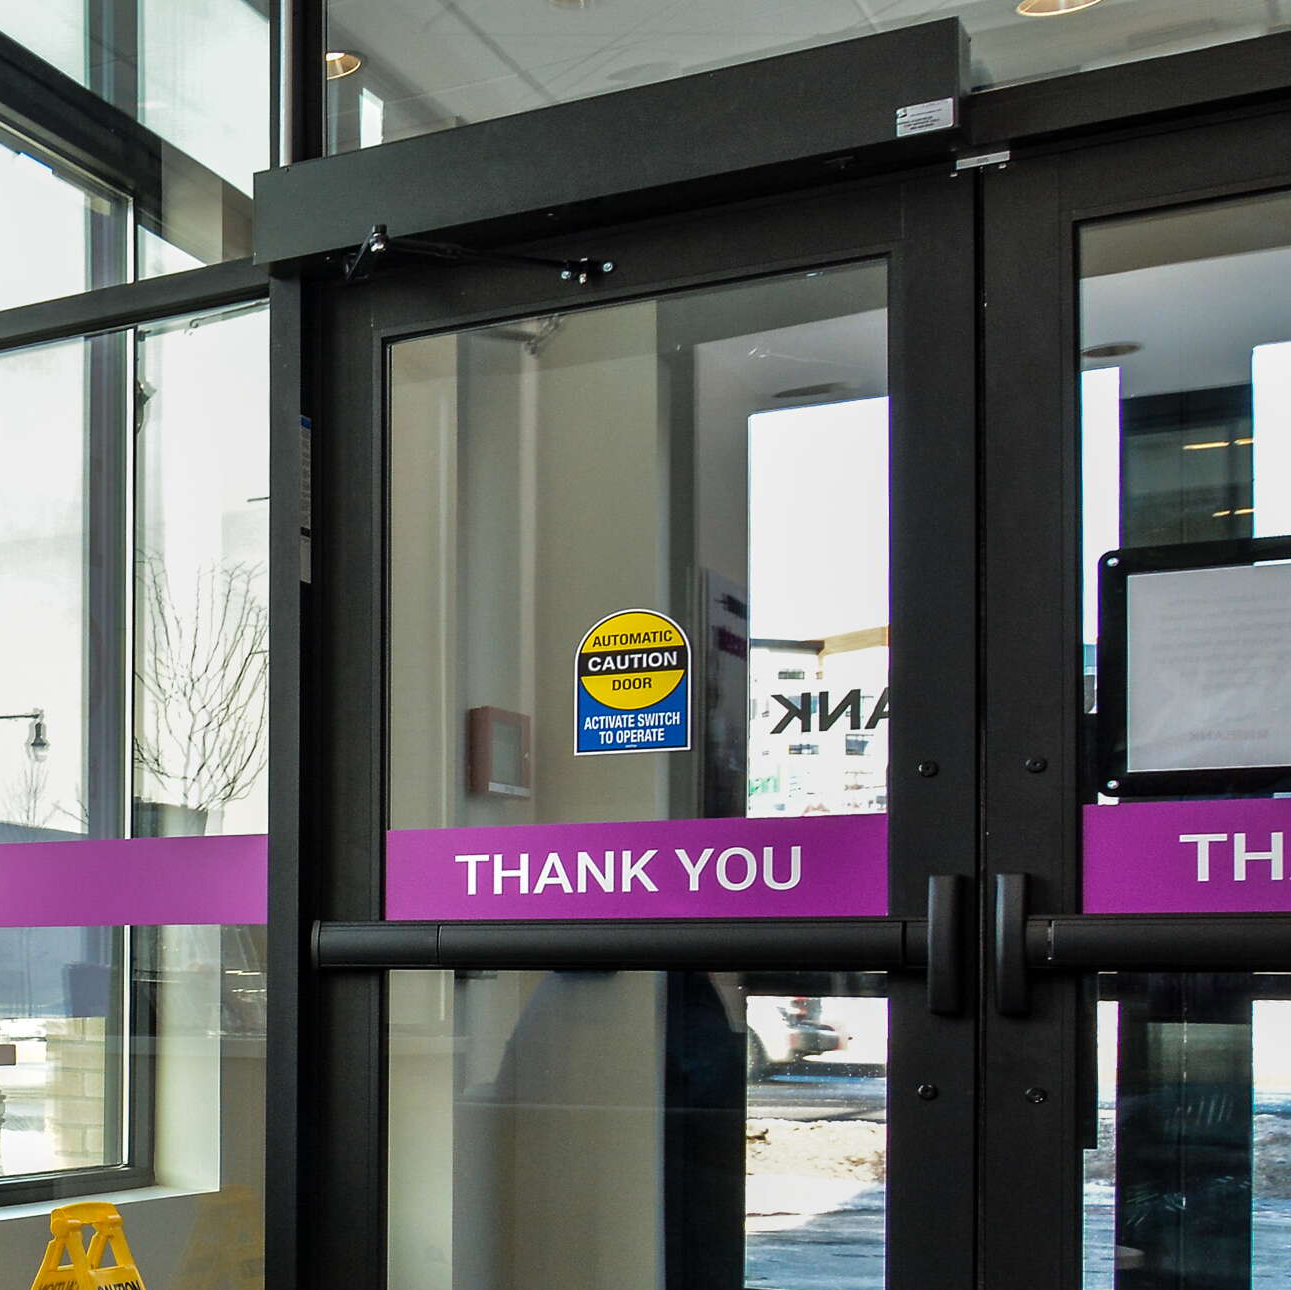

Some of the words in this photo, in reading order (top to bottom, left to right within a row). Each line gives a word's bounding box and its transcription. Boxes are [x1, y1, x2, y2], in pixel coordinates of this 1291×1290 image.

[592, 629, 674, 648] AUTOMATIC
[587, 651, 678, 673] CAUTION
[612, 677, 652, 691] DOOR
[583, 714, 636, 731] ACTIVATE
[637, 711, 681, 727] SWITCH
[599, 731, 614, 745] TO
[615, 728, 666, 744] OPERATE
[1179, 832, 1291, 882] TH
[454, 849, 659, 896] THANK
[673, 845, 803, 892] YOU
